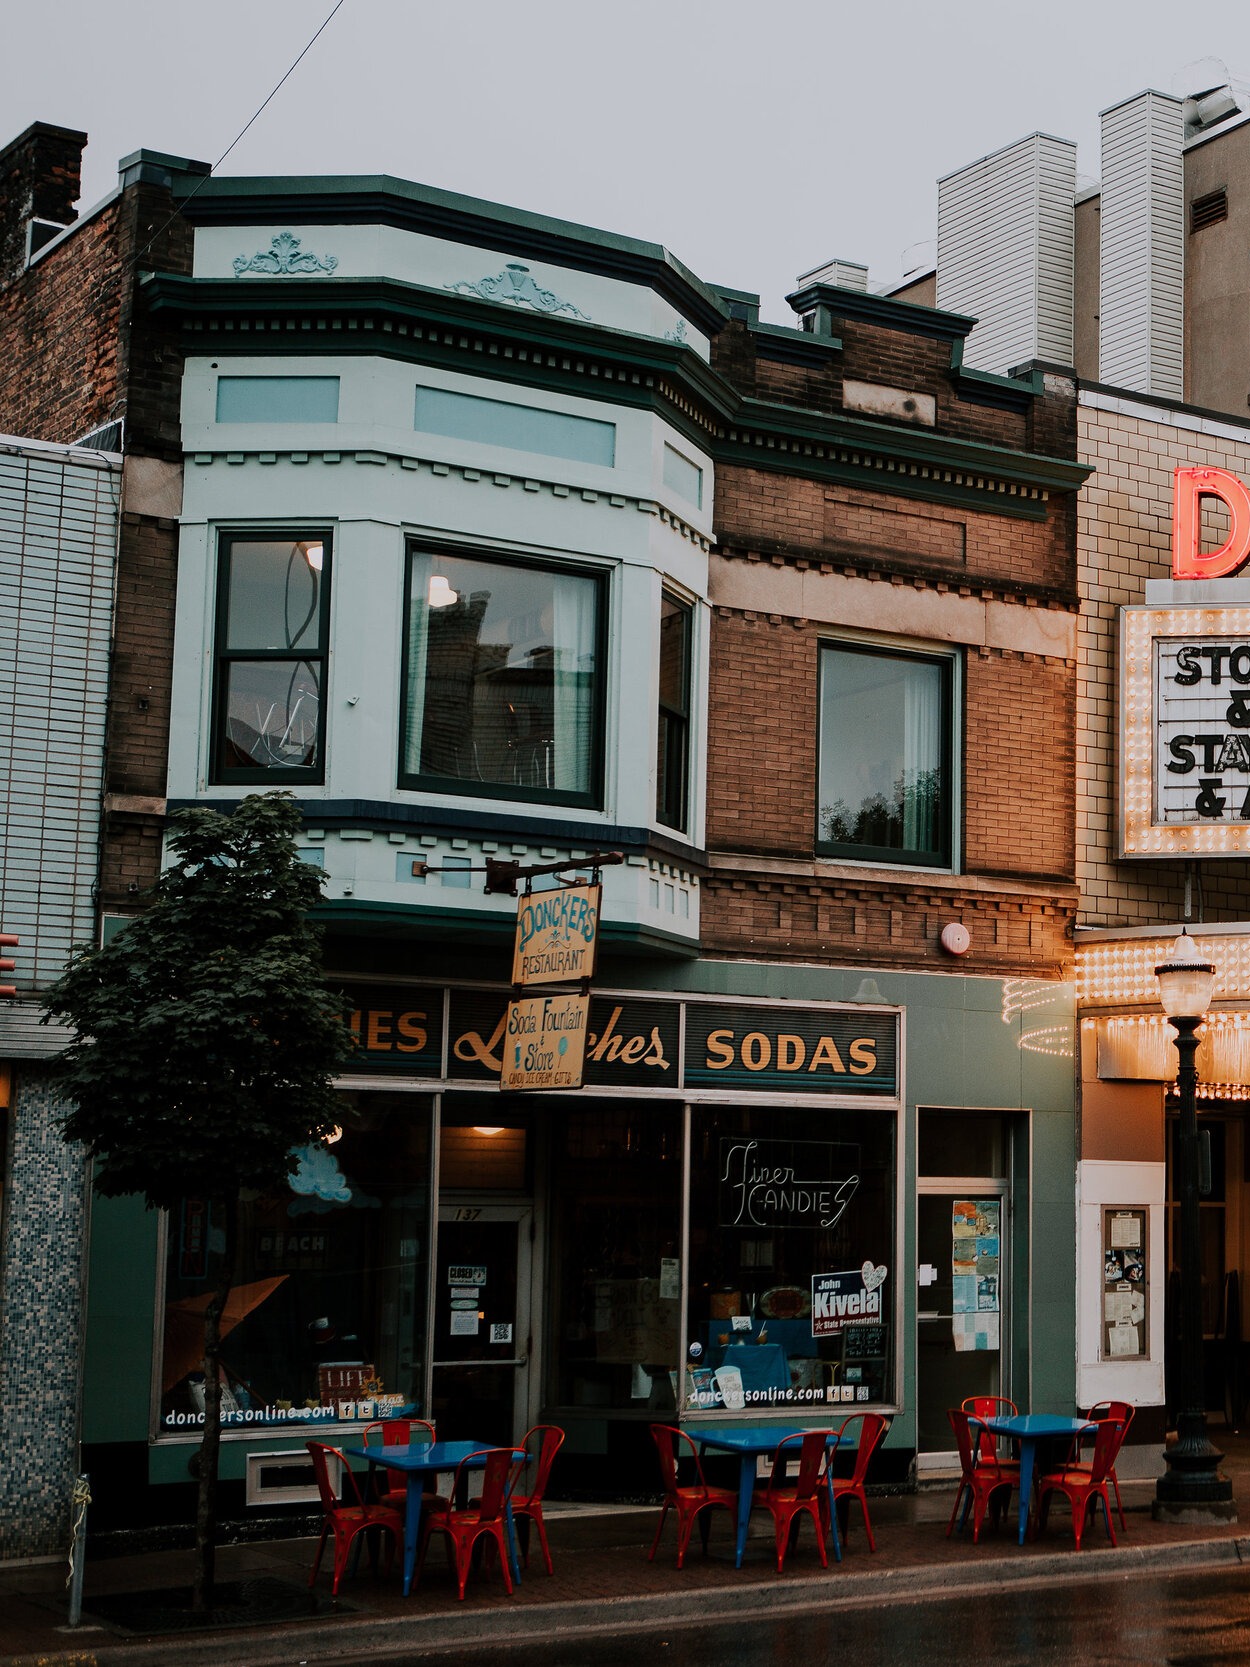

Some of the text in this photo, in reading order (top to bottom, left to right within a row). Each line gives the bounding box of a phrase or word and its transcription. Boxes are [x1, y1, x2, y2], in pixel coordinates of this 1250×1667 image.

[1195, 778, 1226, 817] &
[517, 891, 597, 953] DONCKERS
[521, 949, 586, 979] RESTAURANT
[509, 999, 584, 1035] Soda Fountain
[453, 1006, 670, 1072] Lhes
[706, 1029, 877, 1075] SODAS
[524, 1043, 554, 1072] Store
[455, 1209, 481, 1221] 137
[183, 1199, 205, 1276] PEN
[450, 1268, 473, 1278] CLOSED
[818, 1279, 841, 1290] John
[815, 1288, 879, 1319] Kivela
[824, 1320, 839, 1329] State
[166, 1404, 335, 1424] doncersonline.com
